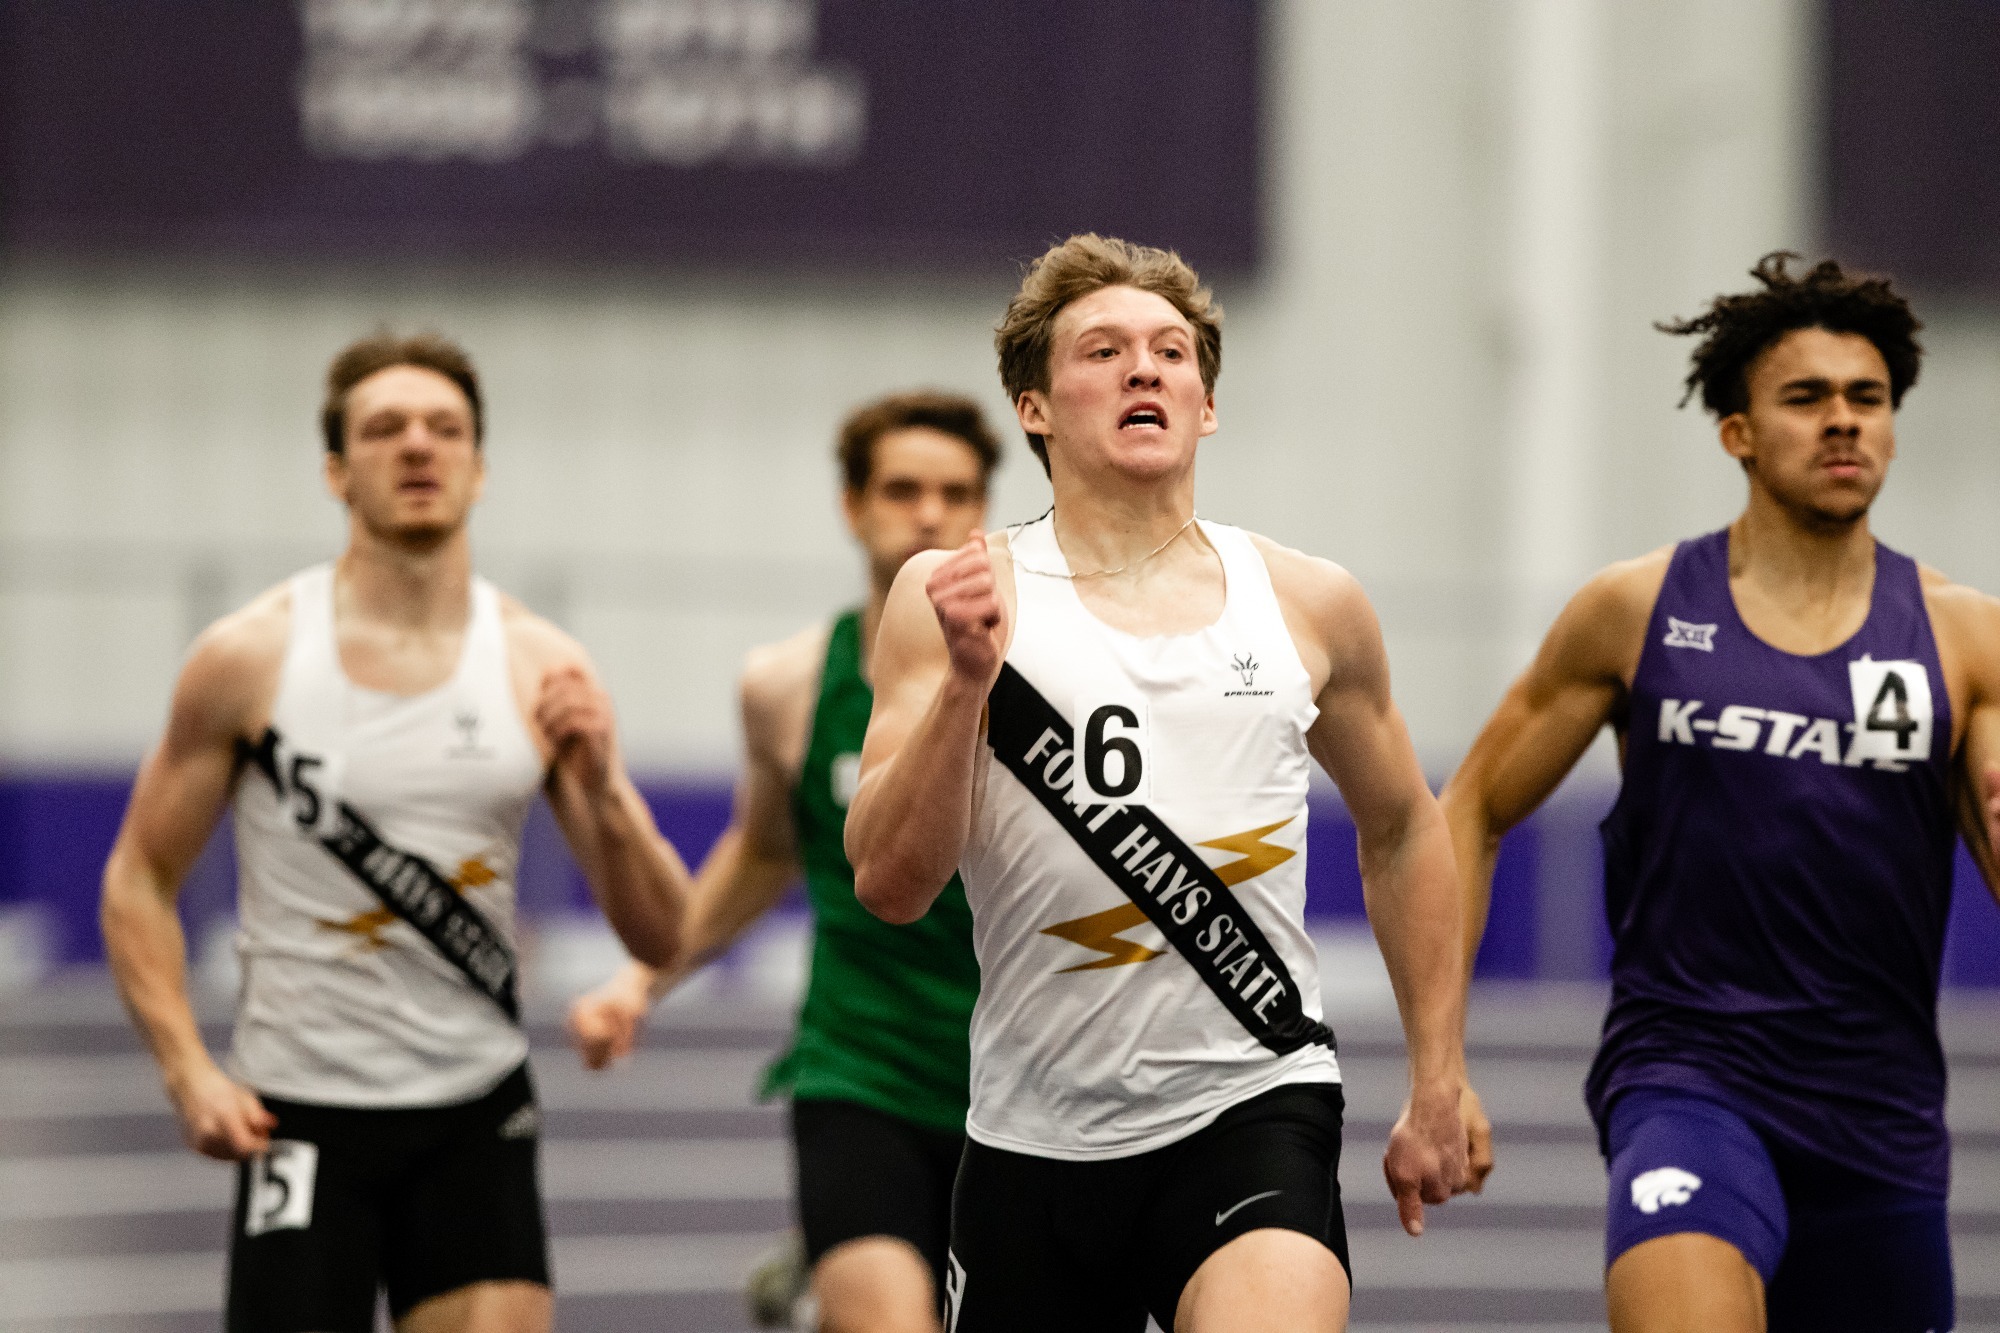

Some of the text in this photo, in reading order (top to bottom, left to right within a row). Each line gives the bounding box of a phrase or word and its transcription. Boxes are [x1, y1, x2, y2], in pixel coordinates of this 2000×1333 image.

[1657, 699, 1910, 773] K-STA
[1866, 671, 1918, 750] 4
[290, 754, 323, 825] 5
[1084, 704, 1143, 798] 6
[1022, 725, 1287, 1025] FOT HAYS STATE
[263, 1143, 293, 1219] 5
